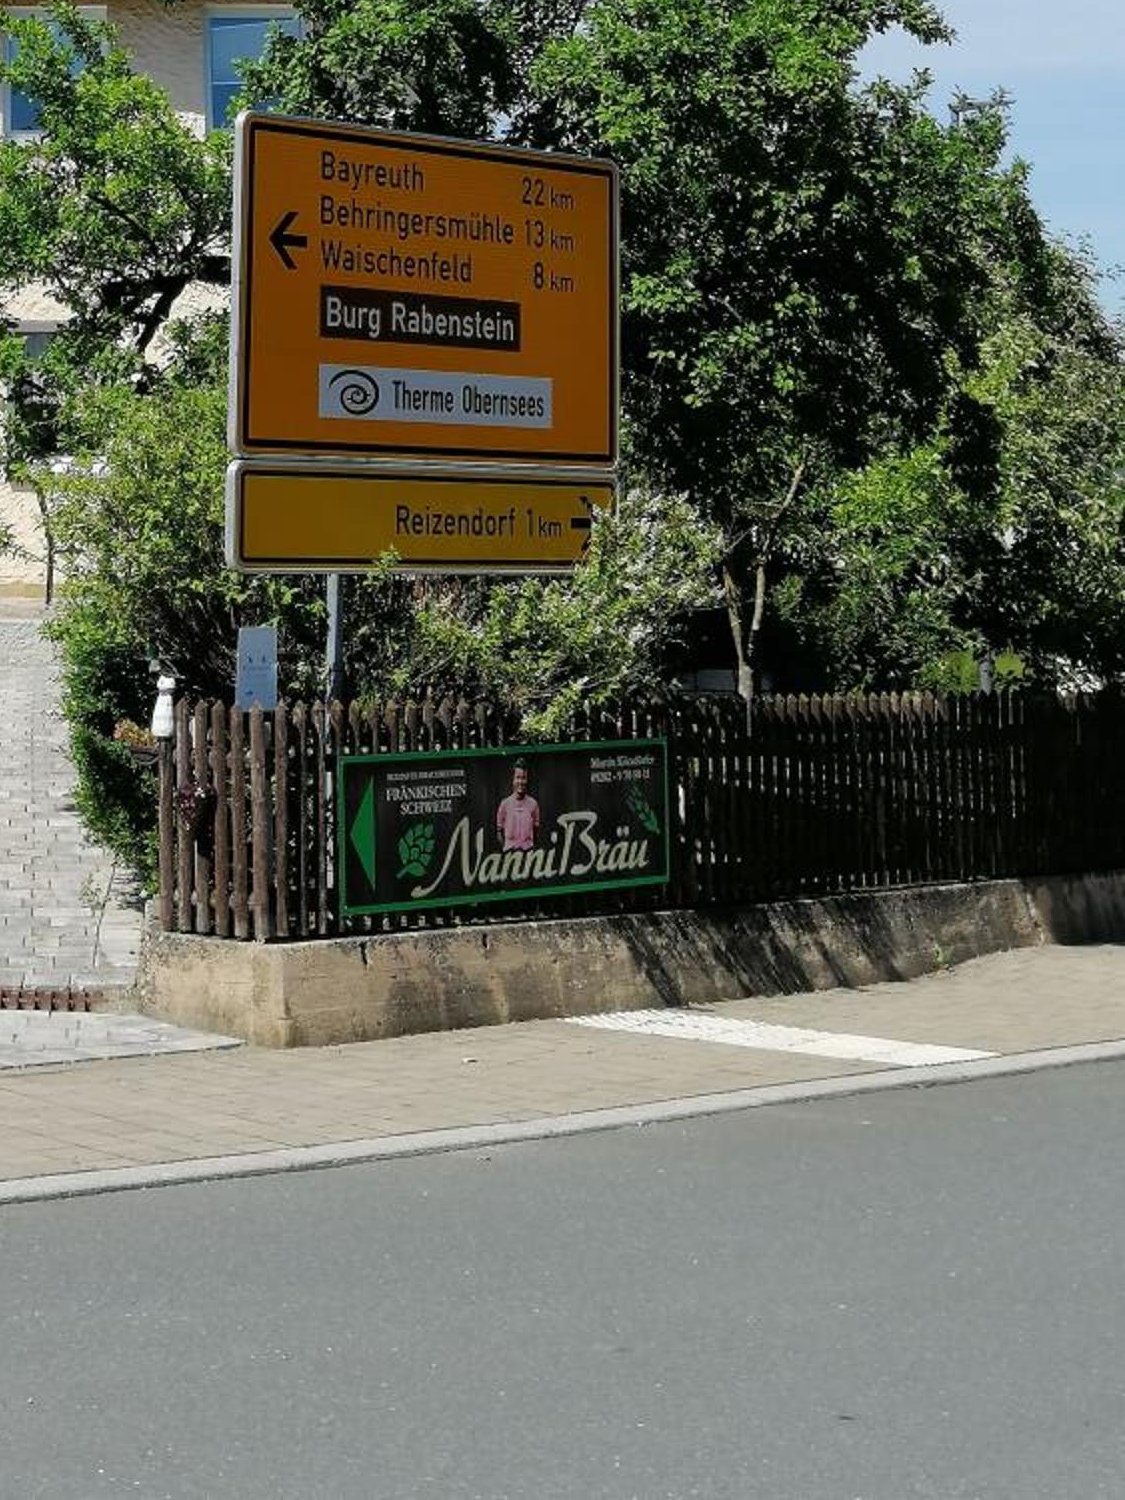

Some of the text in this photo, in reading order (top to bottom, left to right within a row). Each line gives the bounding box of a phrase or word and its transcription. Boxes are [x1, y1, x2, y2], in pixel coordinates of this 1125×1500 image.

[321, 151, 574, 210] Bayreuth 22 km
[320, 196, 574, 252] Behringersmühle 13 km
[321, 240, 574, 292] Waischenfeld 8 km
[326, 297, 515, 341] Burg Rabenstein
[391, 380, 544, 417] Therme Obernsees
[395, 505, 516, 537] Reizendorf
[538, 516, 562, 538] km
[411, 811, 649, 898] Nanni Bräu
